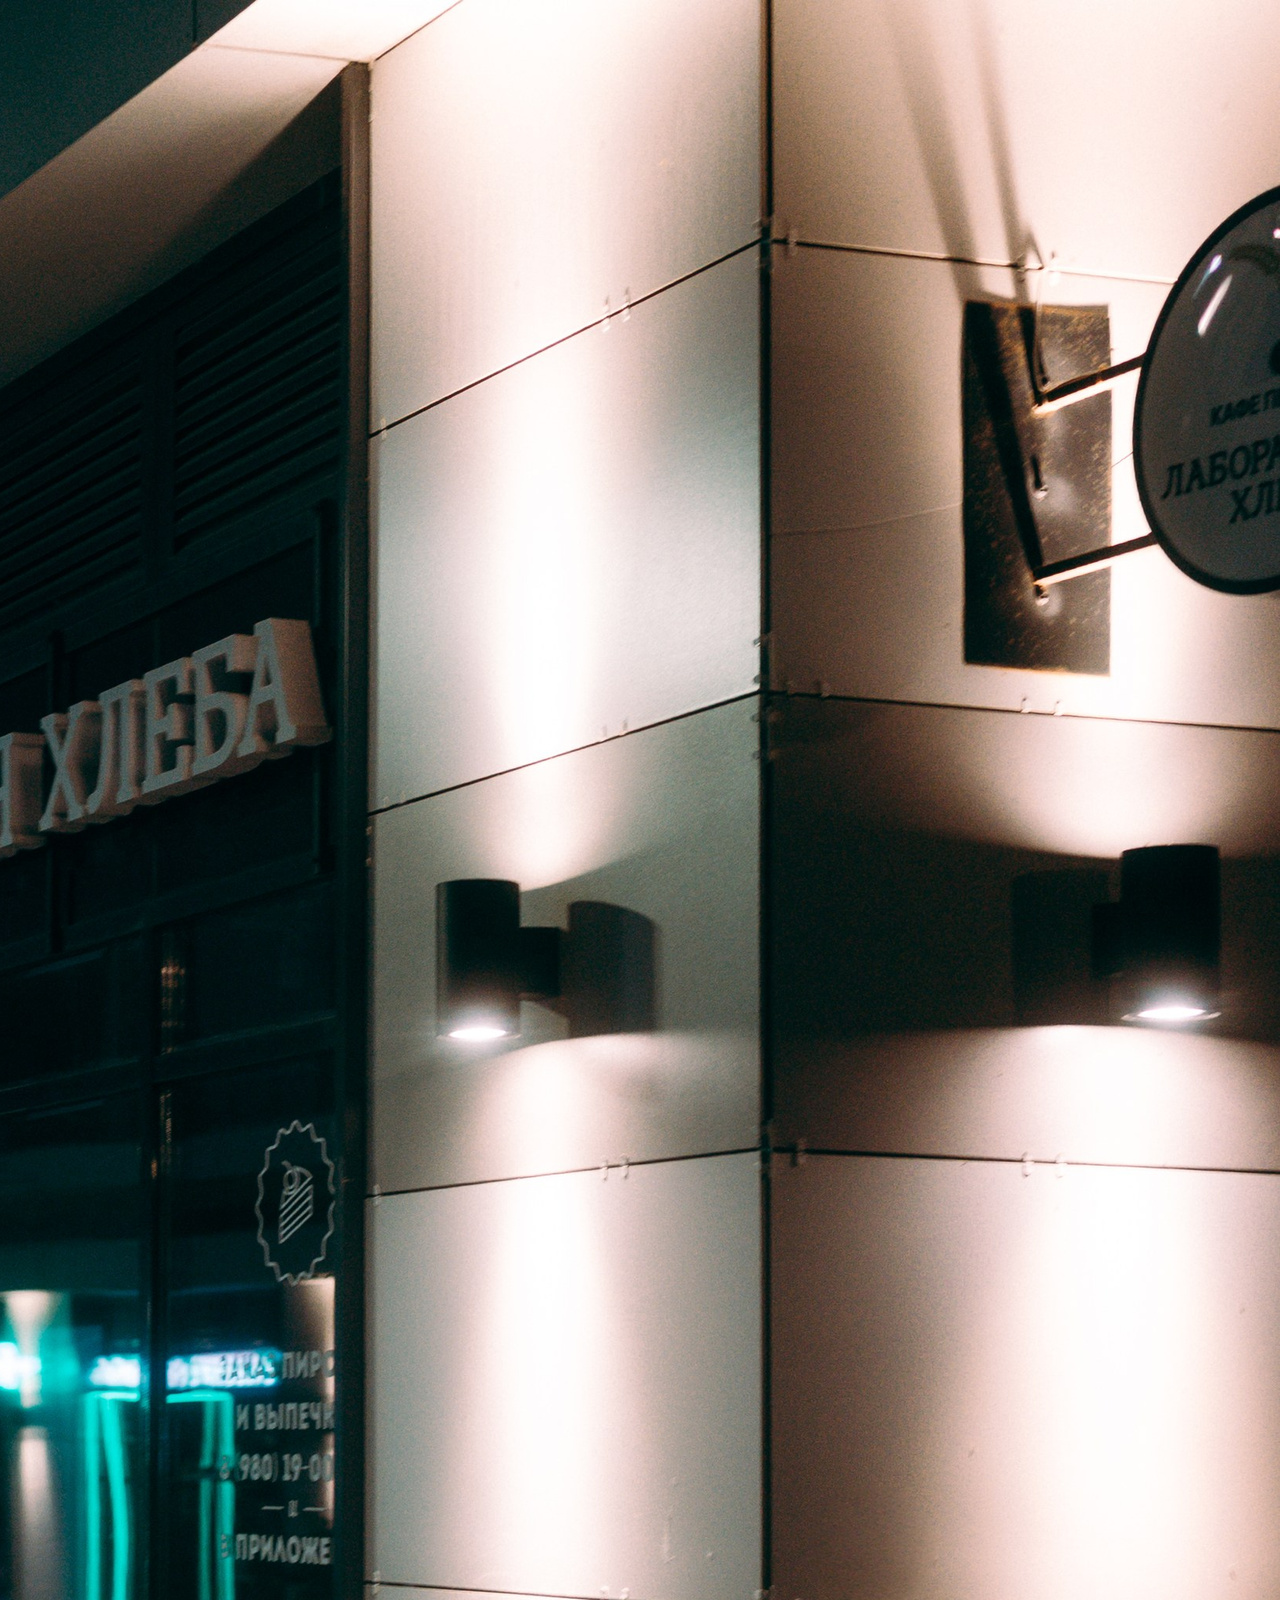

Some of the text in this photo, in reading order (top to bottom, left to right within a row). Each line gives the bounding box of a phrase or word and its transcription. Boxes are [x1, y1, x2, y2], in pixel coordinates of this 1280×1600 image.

[1209, 393, 1261, 426] КАФЕ
[1229, 479, 1280, 523] ХЛ
[40, 617, 308, 832] ХЛЕБА
[236, 1404, 249, 1430] И
[235, 1534, 331, 1565] ПРИЛОЖЕ
